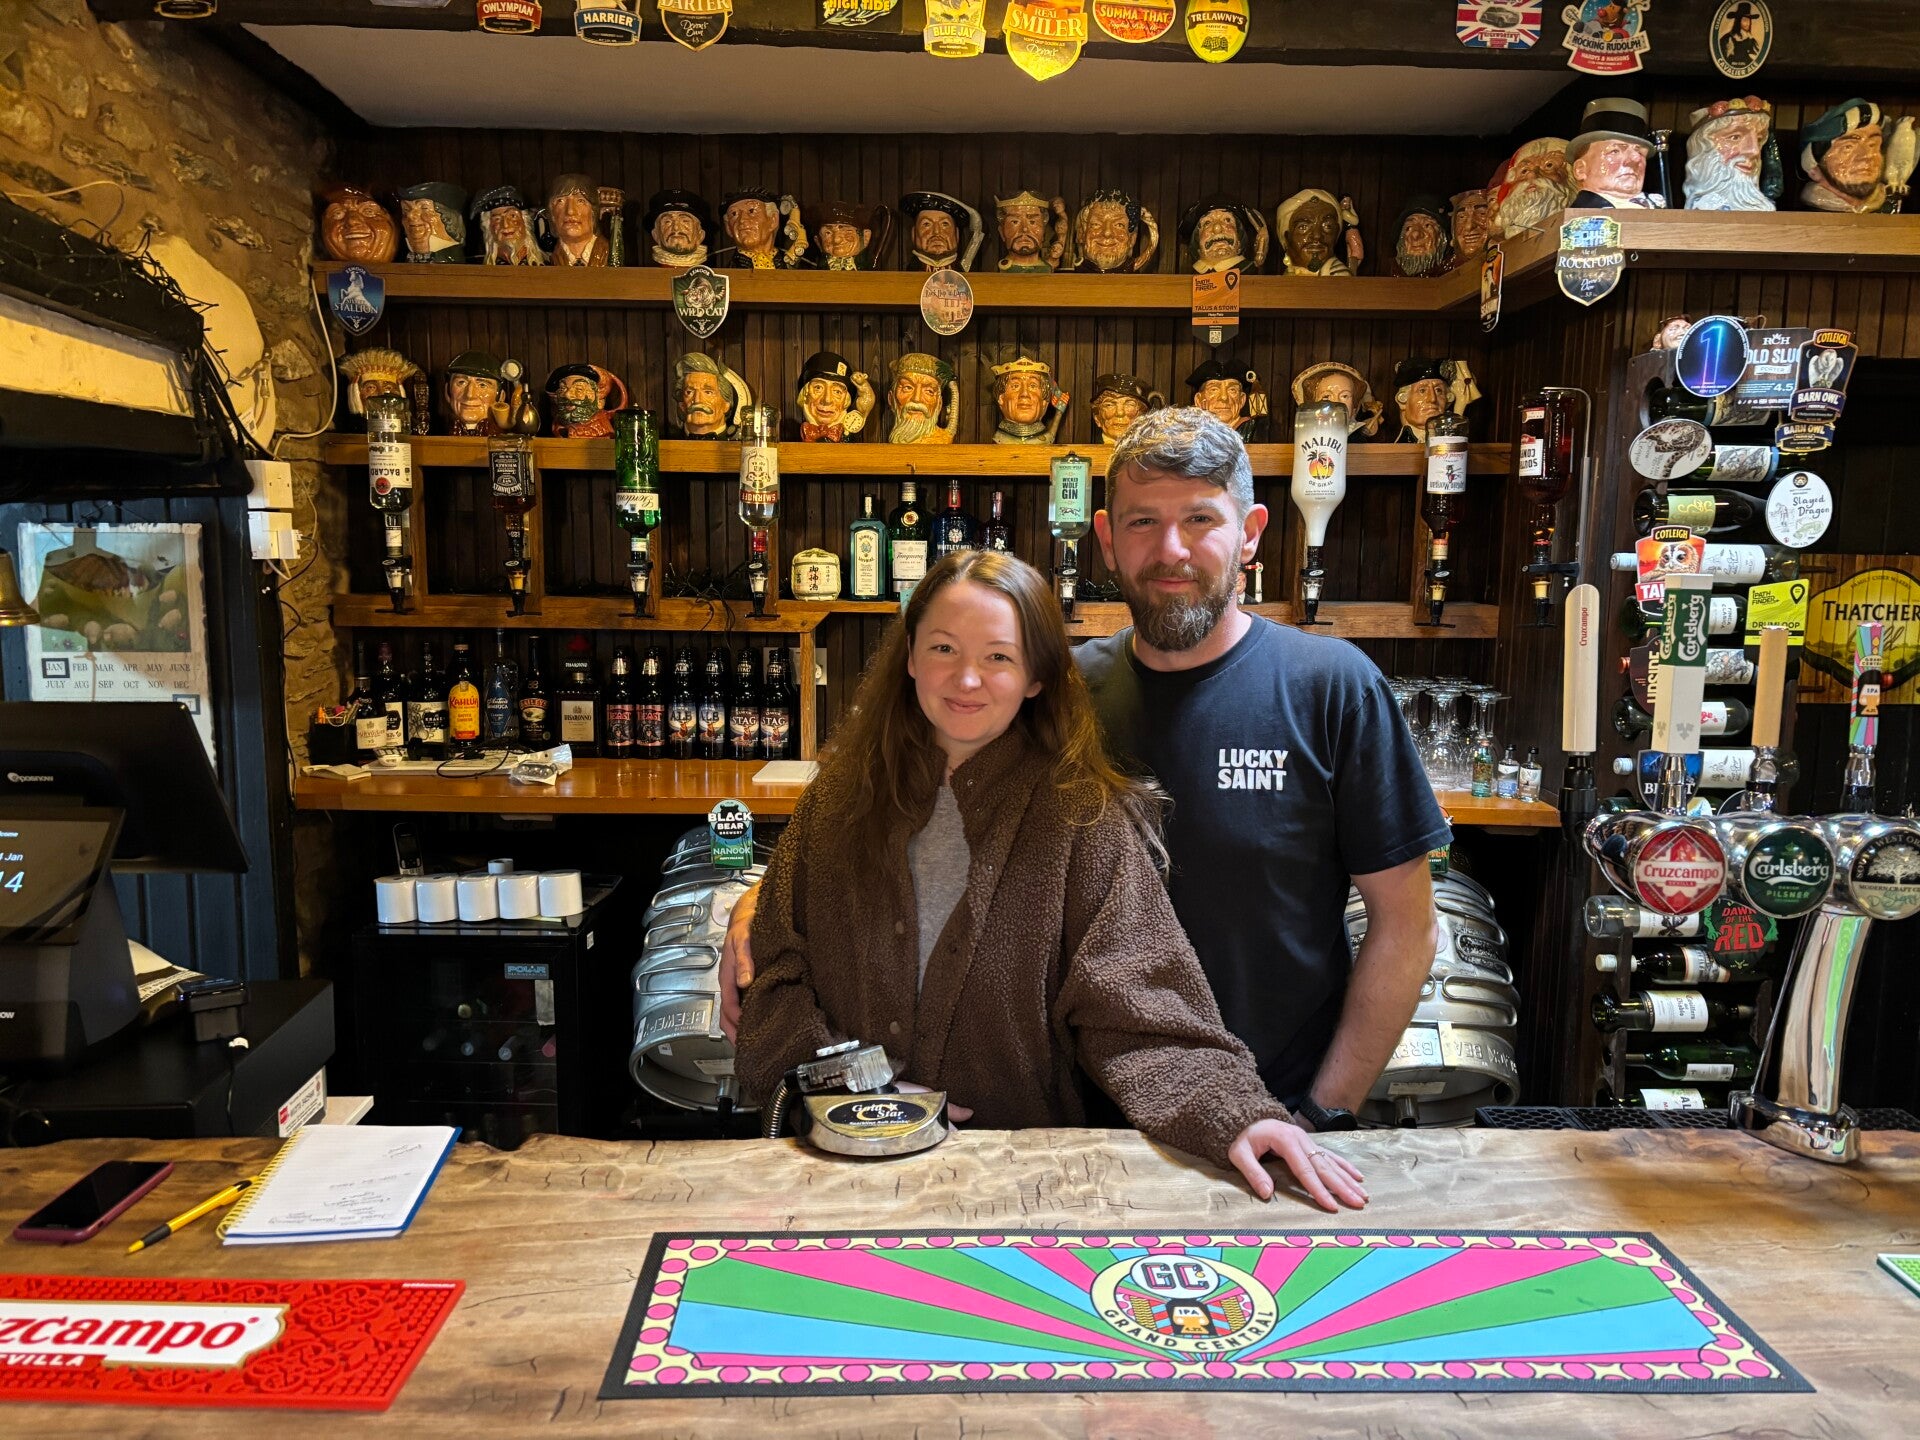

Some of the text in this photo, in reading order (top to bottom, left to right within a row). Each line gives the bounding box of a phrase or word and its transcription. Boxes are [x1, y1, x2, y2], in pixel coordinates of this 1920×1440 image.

[483, 2, 534, 17] OWLYMPIAN
[863, 0, 891, 11] TIDE
[1034, 8, 1057, 18] REAL
[1100, 4, 1170, 23] SUMMA THAT
[1190, 12, 1245, 25] TRELAWNY'S
[583, 13, 633, 27] HARRIER
[1010, 10, 1084, 37] SMILER
[933, 25, 976, 39] BLUE JAY
[1573, 36, 1641, 51] ROCKING RUDOLPH
[1718, 58, 1747, 76] CAVALIER
[1558, 252, 1624, 269] ROCKFORD
[334, 302, 379, 314] STALLION
[1762, 334, 1792, 345] RCH
[1816, 333, 1848, 344] COTLEIGH
[1700, 325, 1723, 385] 1
[1773, 383, 1794, 391] 4.5
[1797, 392, 1839, 404] BARN OWL
[1783, 425, 1825, 435] BARN OWL
[1300, 437, 1344, 454] MALIBU
[1429, 482, 1449, 491] Morgan
[742, 493, 776, 502] SMIRNOFF
[1062, 489, 1078, 499] GIN
[1792, 495, 1826, 509] Slayed
[1797, 506, 1830, 519] Dragon
[1654, 528, 1689, 540] COTLEIGH
[1578, 607, 1589, 646] Cruzcampo
[1660, 593, 1677, 660] Carlsberg
[1678, 594, 1707, 661] Carlsberg
[46, 662, 191, 673] JAN FEB MAR APR MAY JUNE
[45, 680, 190, 690] JULY AUG SEP OCT NOV DEC
[449, 696, 479, 709] KAHLÚA
[519, 698, 549, 709] BAILEYS
[732, 717, 757, 726] STAG
[761, 717, 787, 726] STAG
[1218, 748, 1289, 769] LUCKY
[1217, 768, 1287, 791] SAINT
[707, 811, 755, 822] BLACK
[717, 822, 744, 830] BEAR
[1875, 834, 1904, 847] WEST
[4, 852, 24, 862] Jan
[713, 847, 751, 855] NANOOK
[1643, 864, 1719, 882] Cruzcampo
[1749, 855, 1830, 885] Carlsberg
[1766, 889, 1810, 899] PILSNER
[1714, 923, 1765, 951] RED
[507, 965, 546, 973] POLAR
[851, 1103, 882, 1114] Gold
[877, 1109, 904, 1119] Star
[1141, 1263, 1210, 1290] GC
[1104, 1309, 1274, 1351] GRAND CENTRAL
